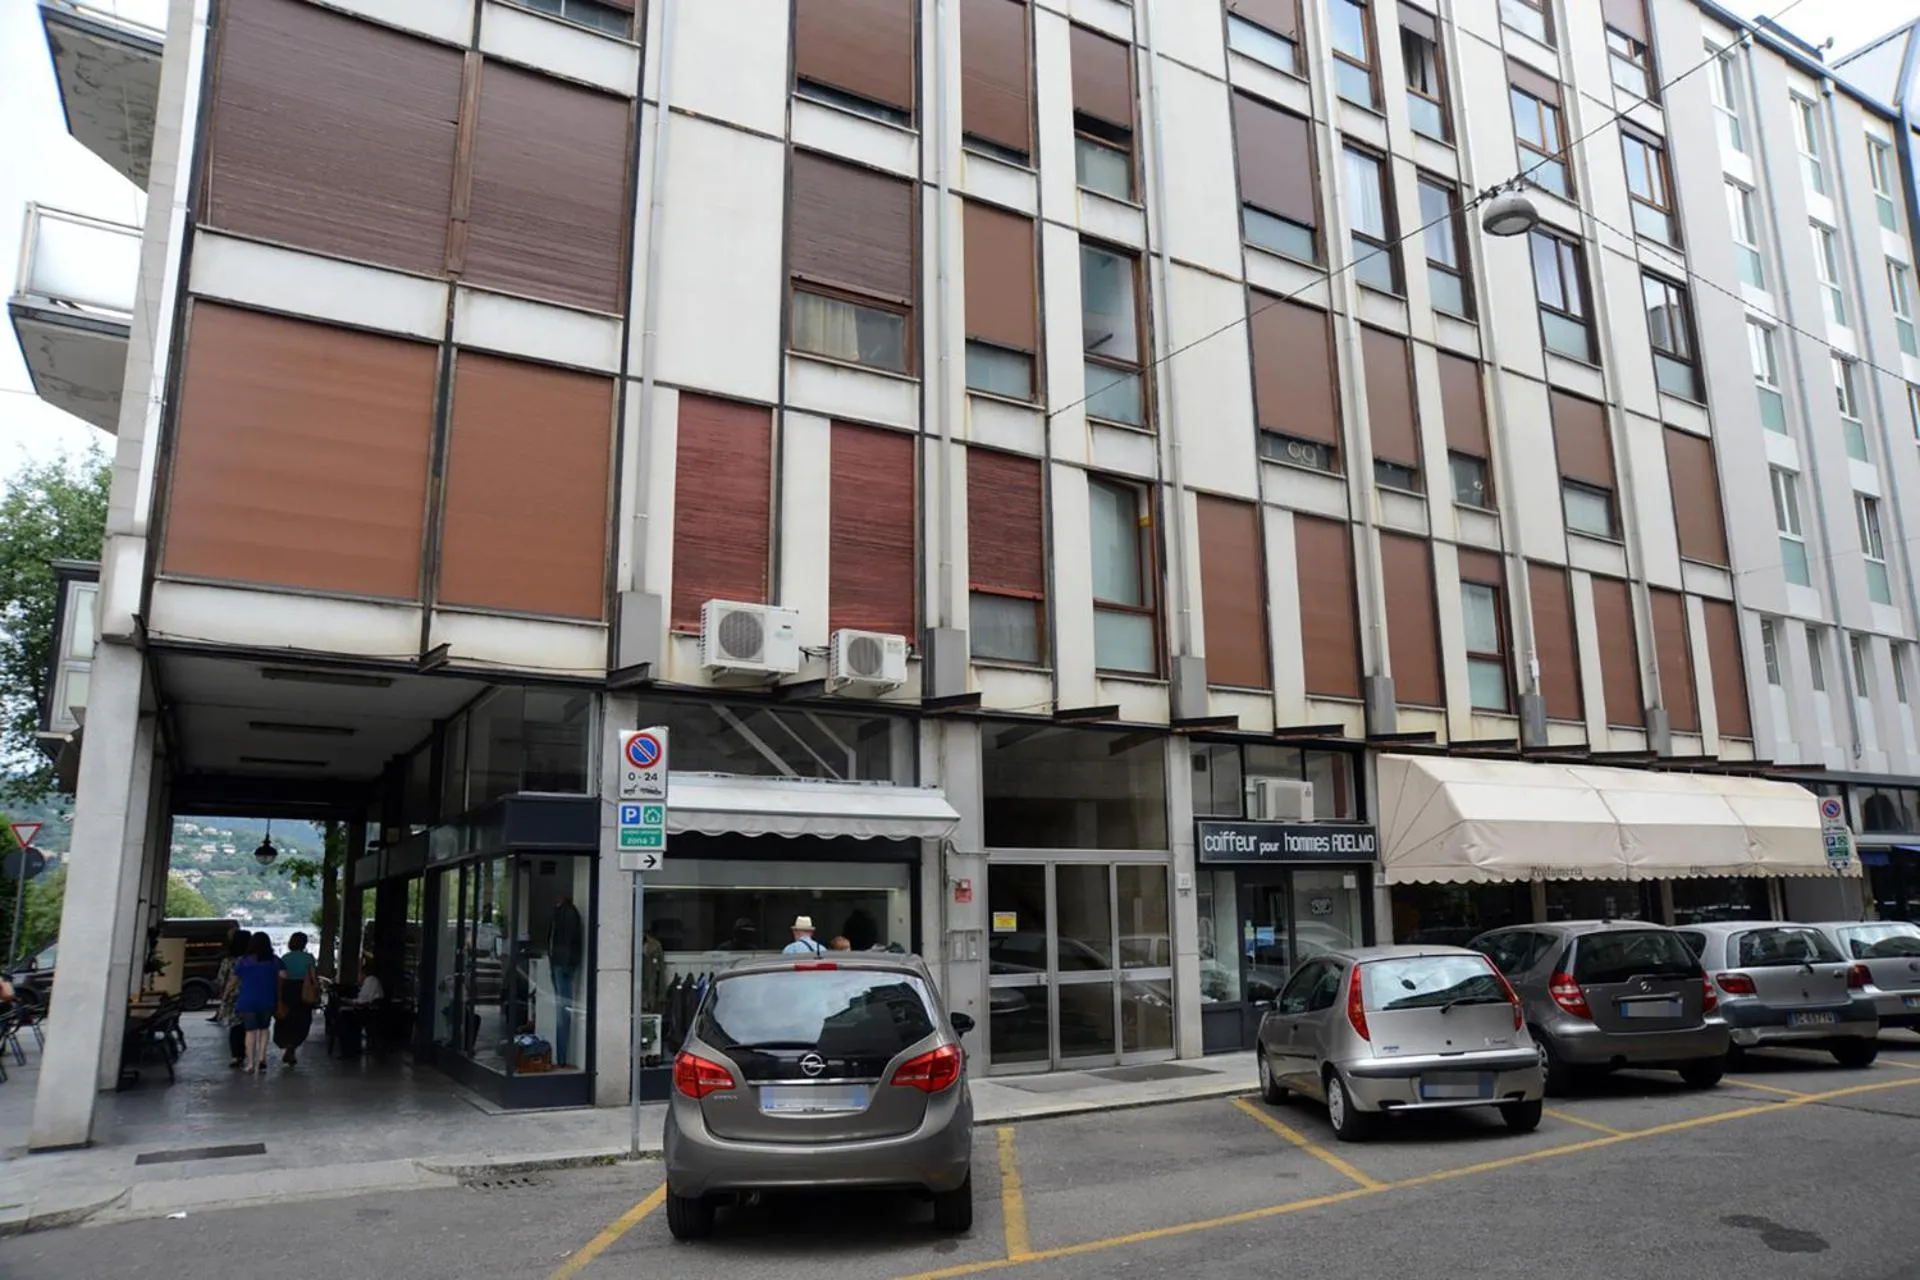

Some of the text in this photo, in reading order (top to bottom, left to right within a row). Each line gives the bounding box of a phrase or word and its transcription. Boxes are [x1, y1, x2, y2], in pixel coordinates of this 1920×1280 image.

[628, 772, 636, 781] 0
[644, 772, 658, 781] 24
[625, 808, 637, 823] P
[627, 837, 648, 845] zona
[1203, 831, 1375, 856] coiffeur pour hommes ADELMO
